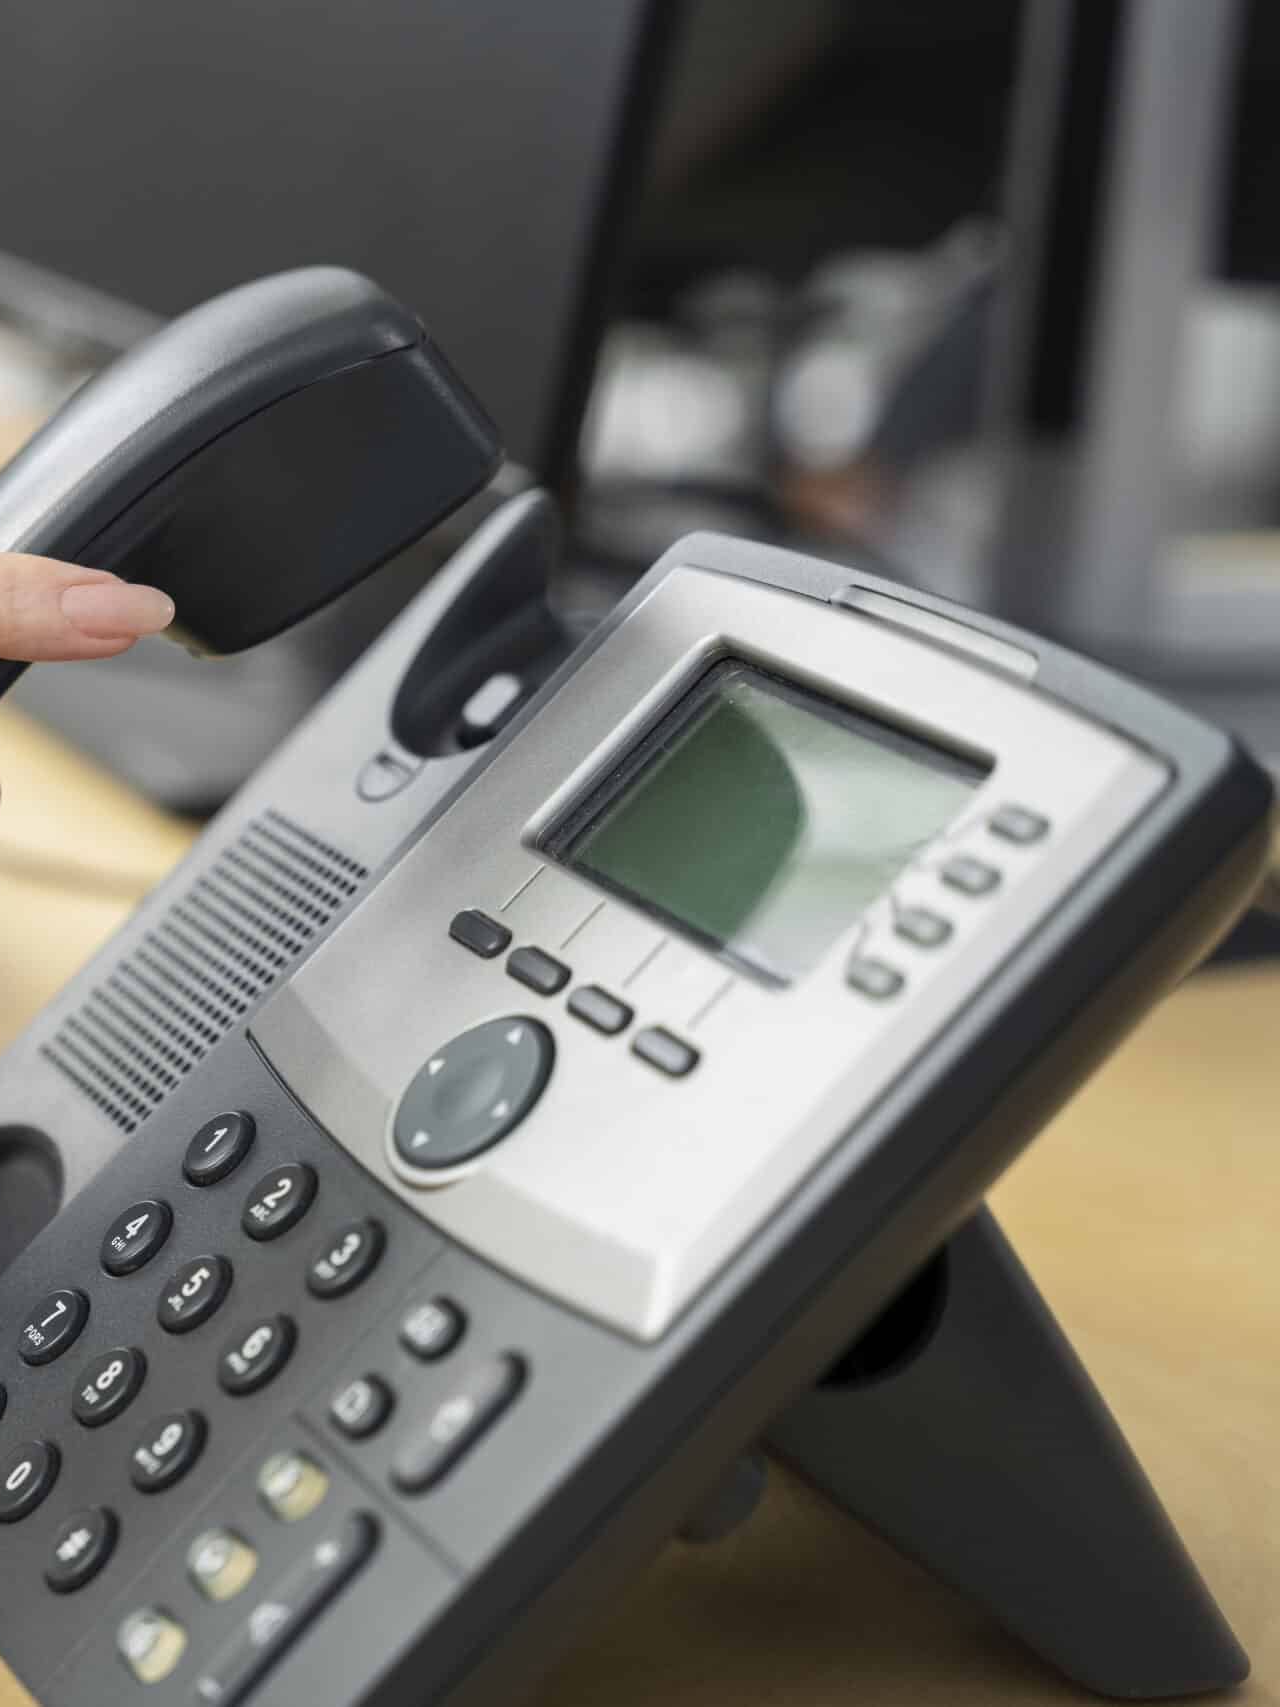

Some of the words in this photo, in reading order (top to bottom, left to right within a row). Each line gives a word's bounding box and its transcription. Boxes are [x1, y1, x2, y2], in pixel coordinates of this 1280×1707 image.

[205, 1128, 227, 1152] 1
[263, 1178, 292, 1208] 2
[125, 1213, 149, 1239] 4
[111, 1236, 126, 1252] GHI
[330, 1235, 361, 1272] 3
[182, 1267, 210, 1296] 5
[41, 1300, 67, 1327] 7
[23, 1324, 45, 1346] PQRS
[241, 1326, 272, 1358] 6
[96, 1359, 123, 1389] 8
[151, 1423, 183, 1456] 9
[5, 1461, 32, 1490] 0
